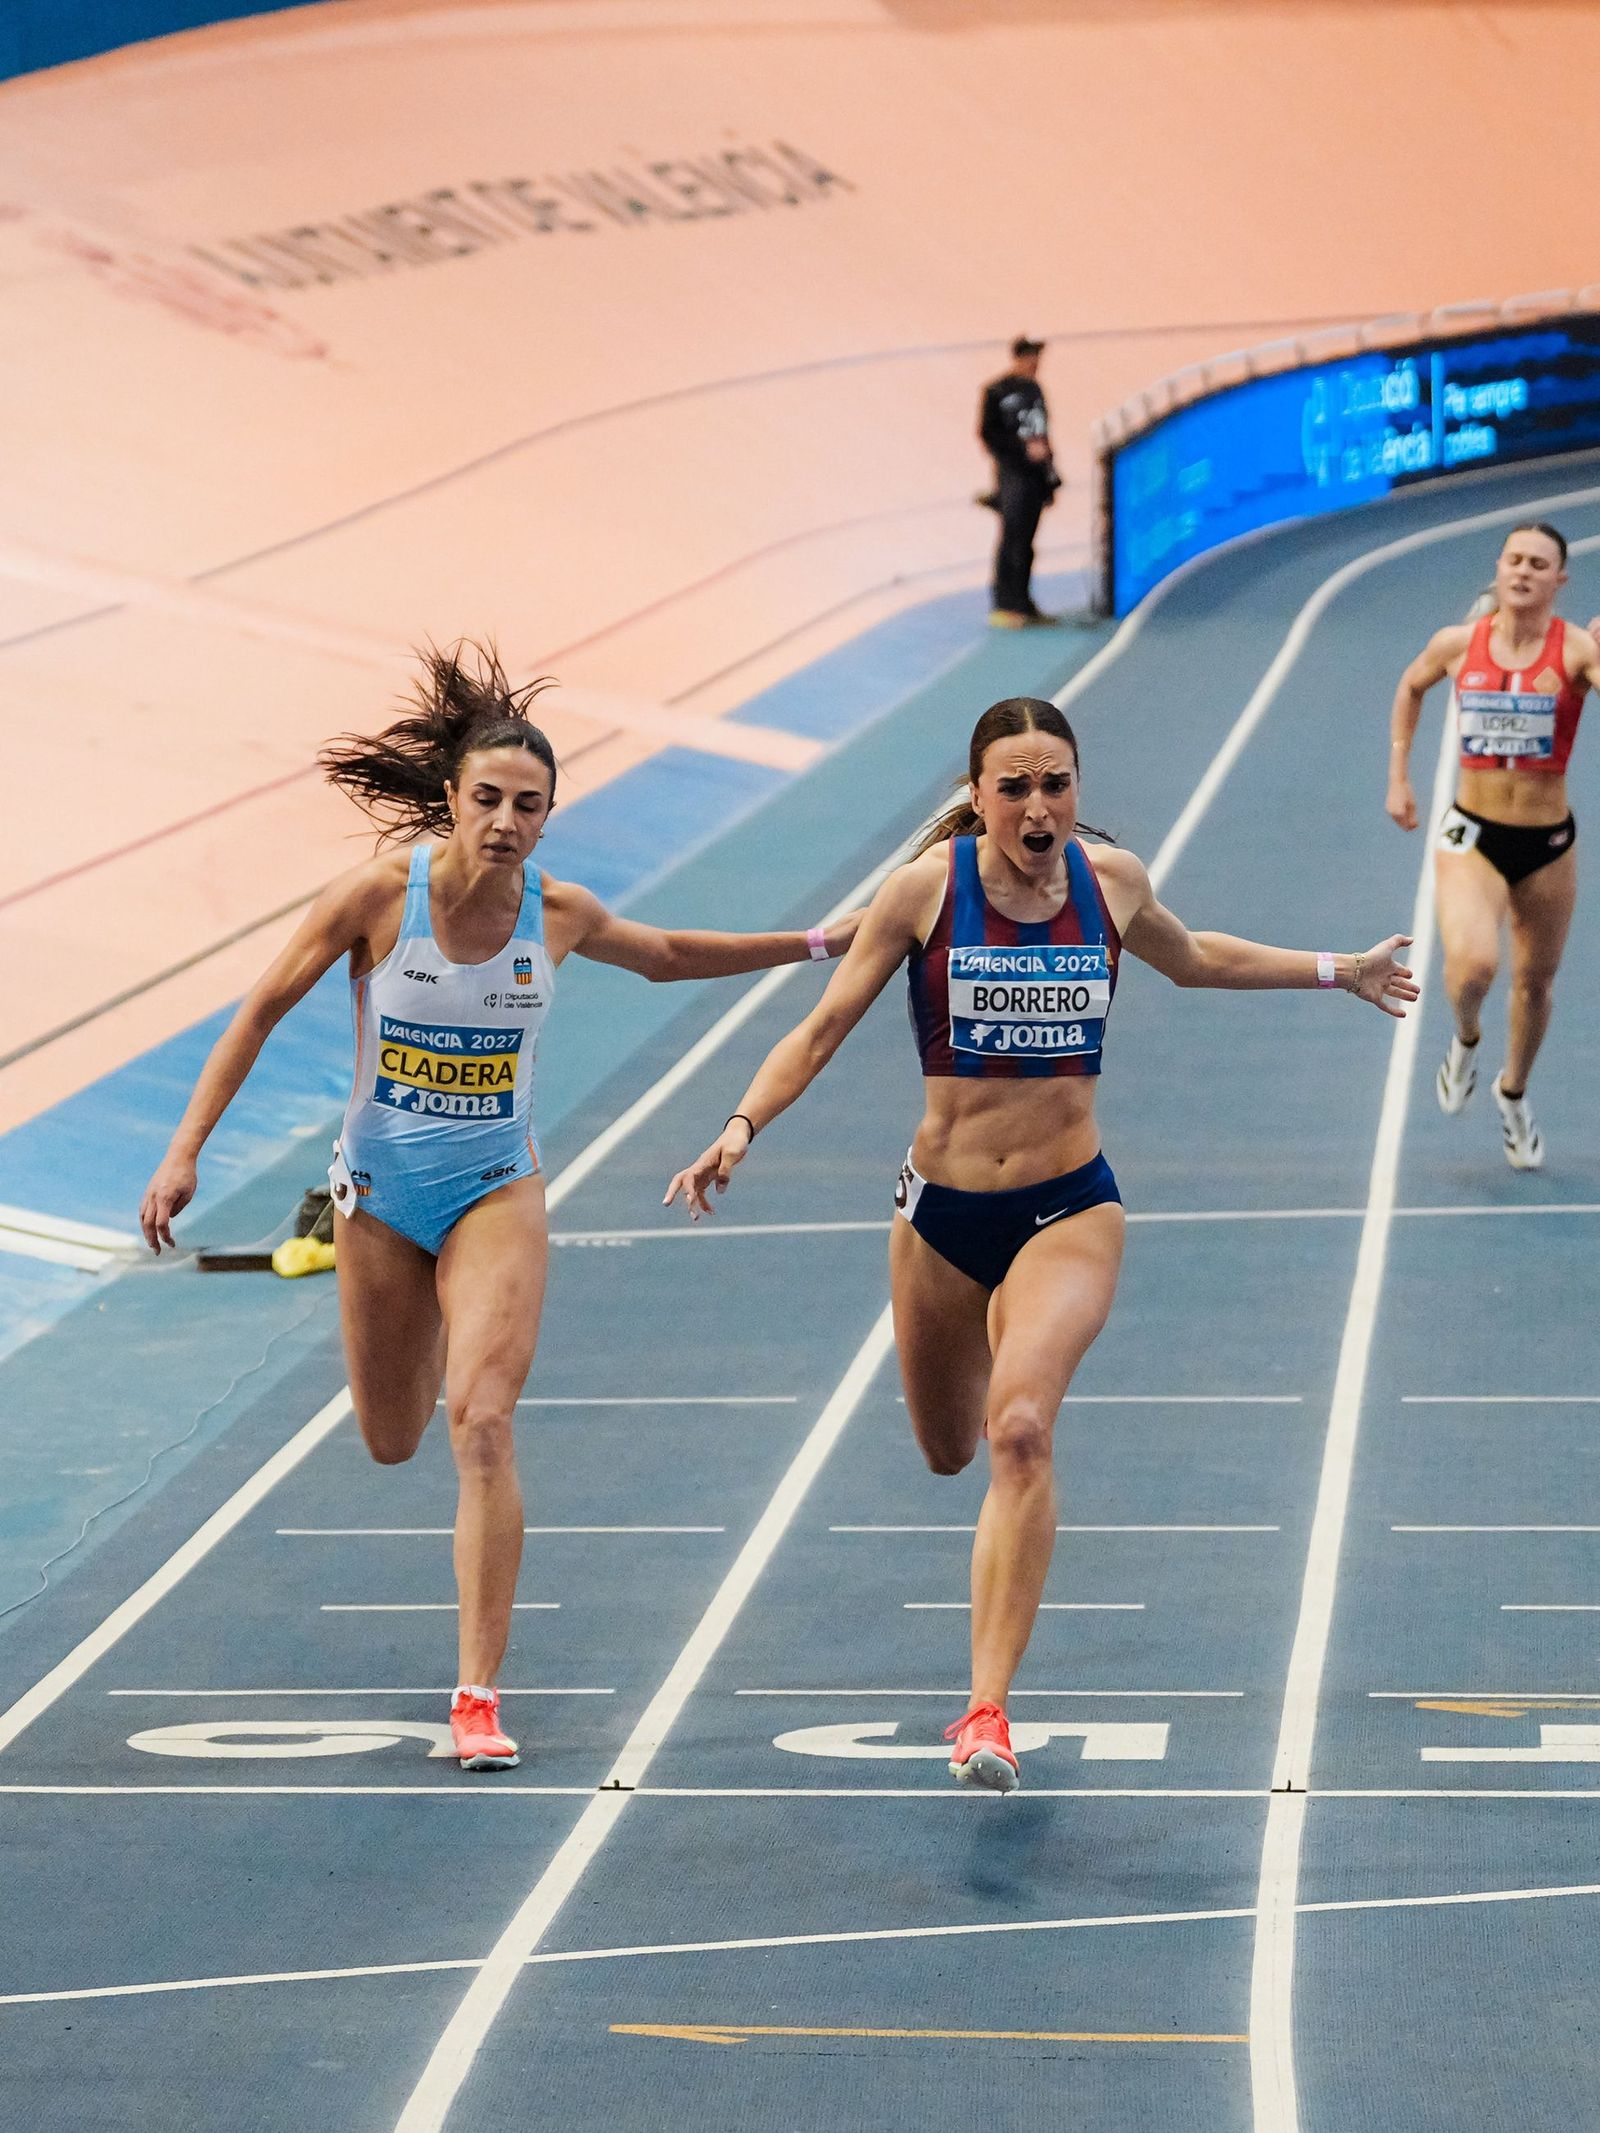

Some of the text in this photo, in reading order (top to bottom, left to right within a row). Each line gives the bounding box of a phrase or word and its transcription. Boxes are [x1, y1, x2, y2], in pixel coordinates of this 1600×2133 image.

[1482, 716, 1528, 732] LOPEZ
[1445, 825, 1466, 845] 4
[959, 955, 1100, 973] VALENCIA 2027
[403, 969, 439, 984] 42K
[504, 993, 538, 1001] Diputació
[973, 986, 1090, 1013] BORRERO
[383, 1021, 518, 1050] VALENCIA 2027
[381, 1048, 514, 1087] CLADERA
[772, 1722, 1170, 1760] 5
